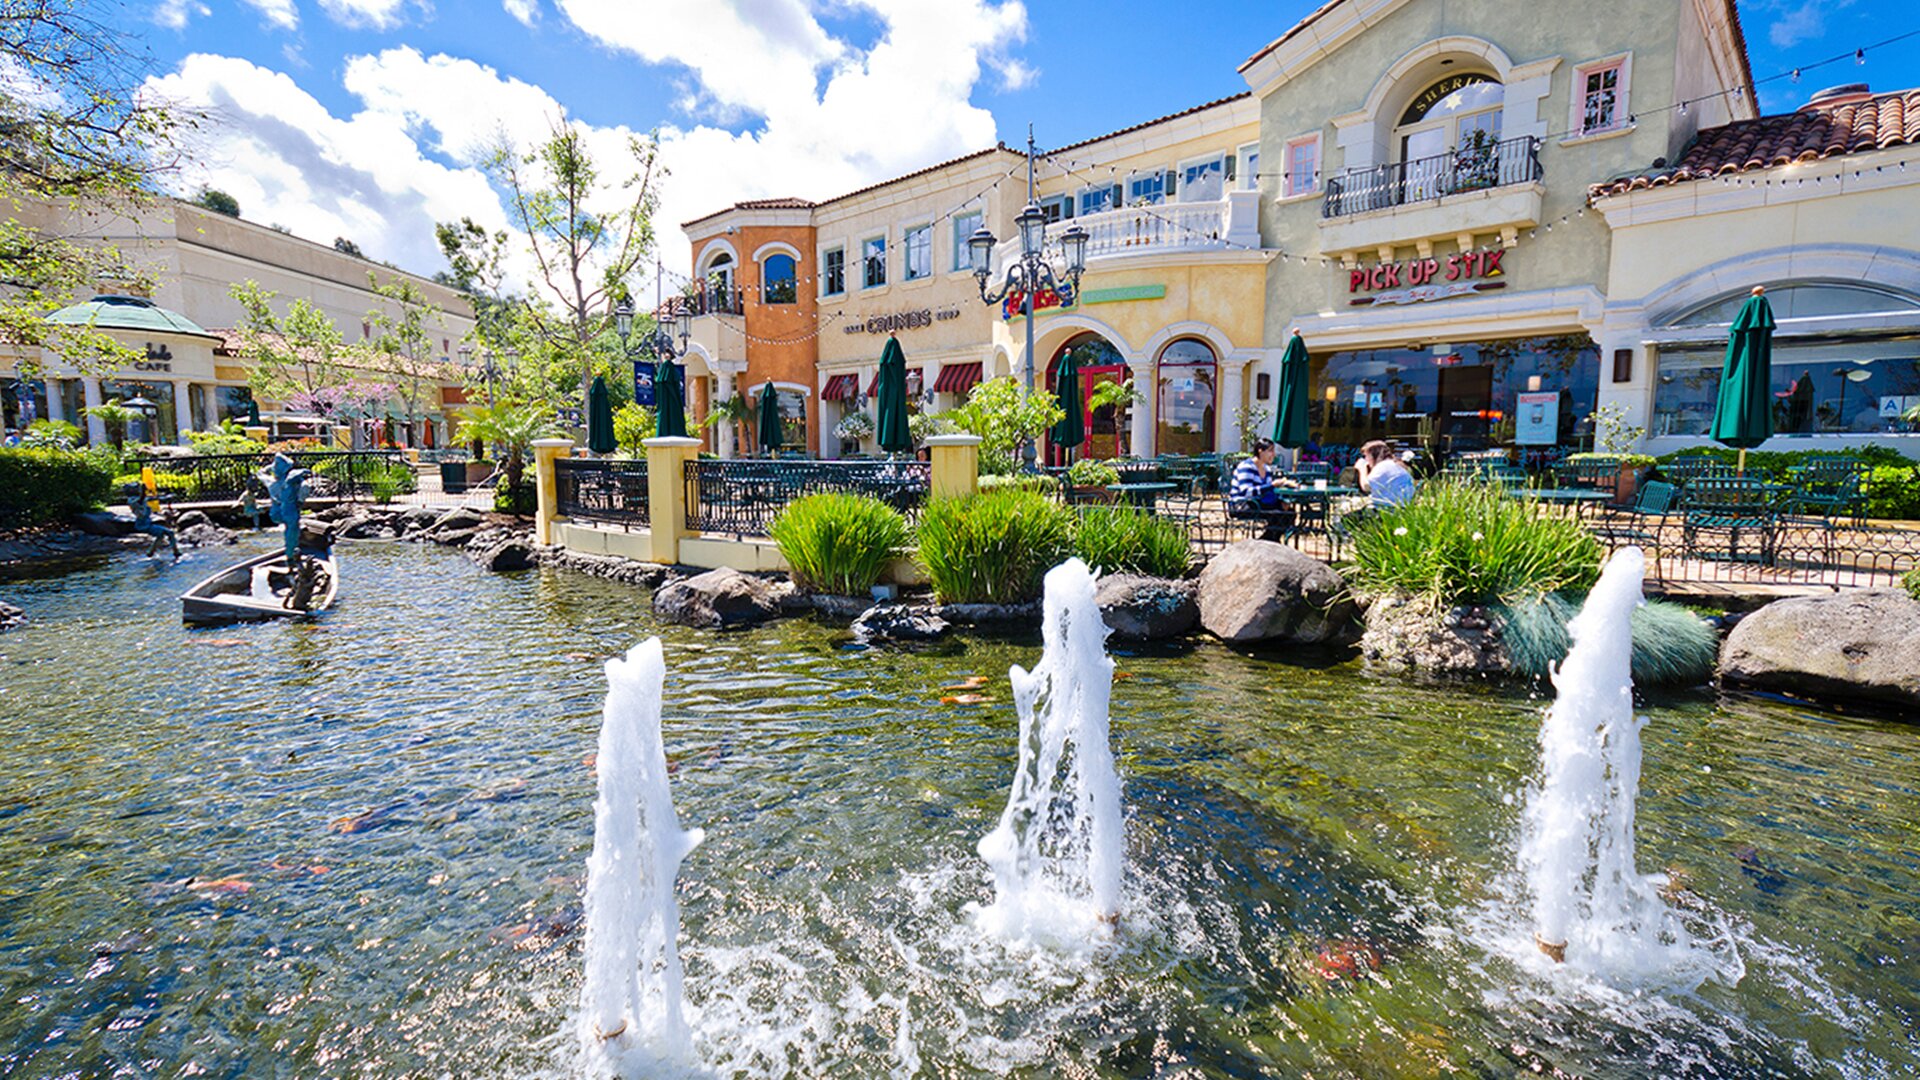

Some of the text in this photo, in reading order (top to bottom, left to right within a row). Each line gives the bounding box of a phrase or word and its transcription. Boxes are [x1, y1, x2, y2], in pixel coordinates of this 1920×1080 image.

[1350, 249, 1506, 293] PICK UP STIX
[867, 308, 932, 334] CRUMBS
[134, 361, 171, 373] CAFE
[1884, 399, 1898, 410] A
